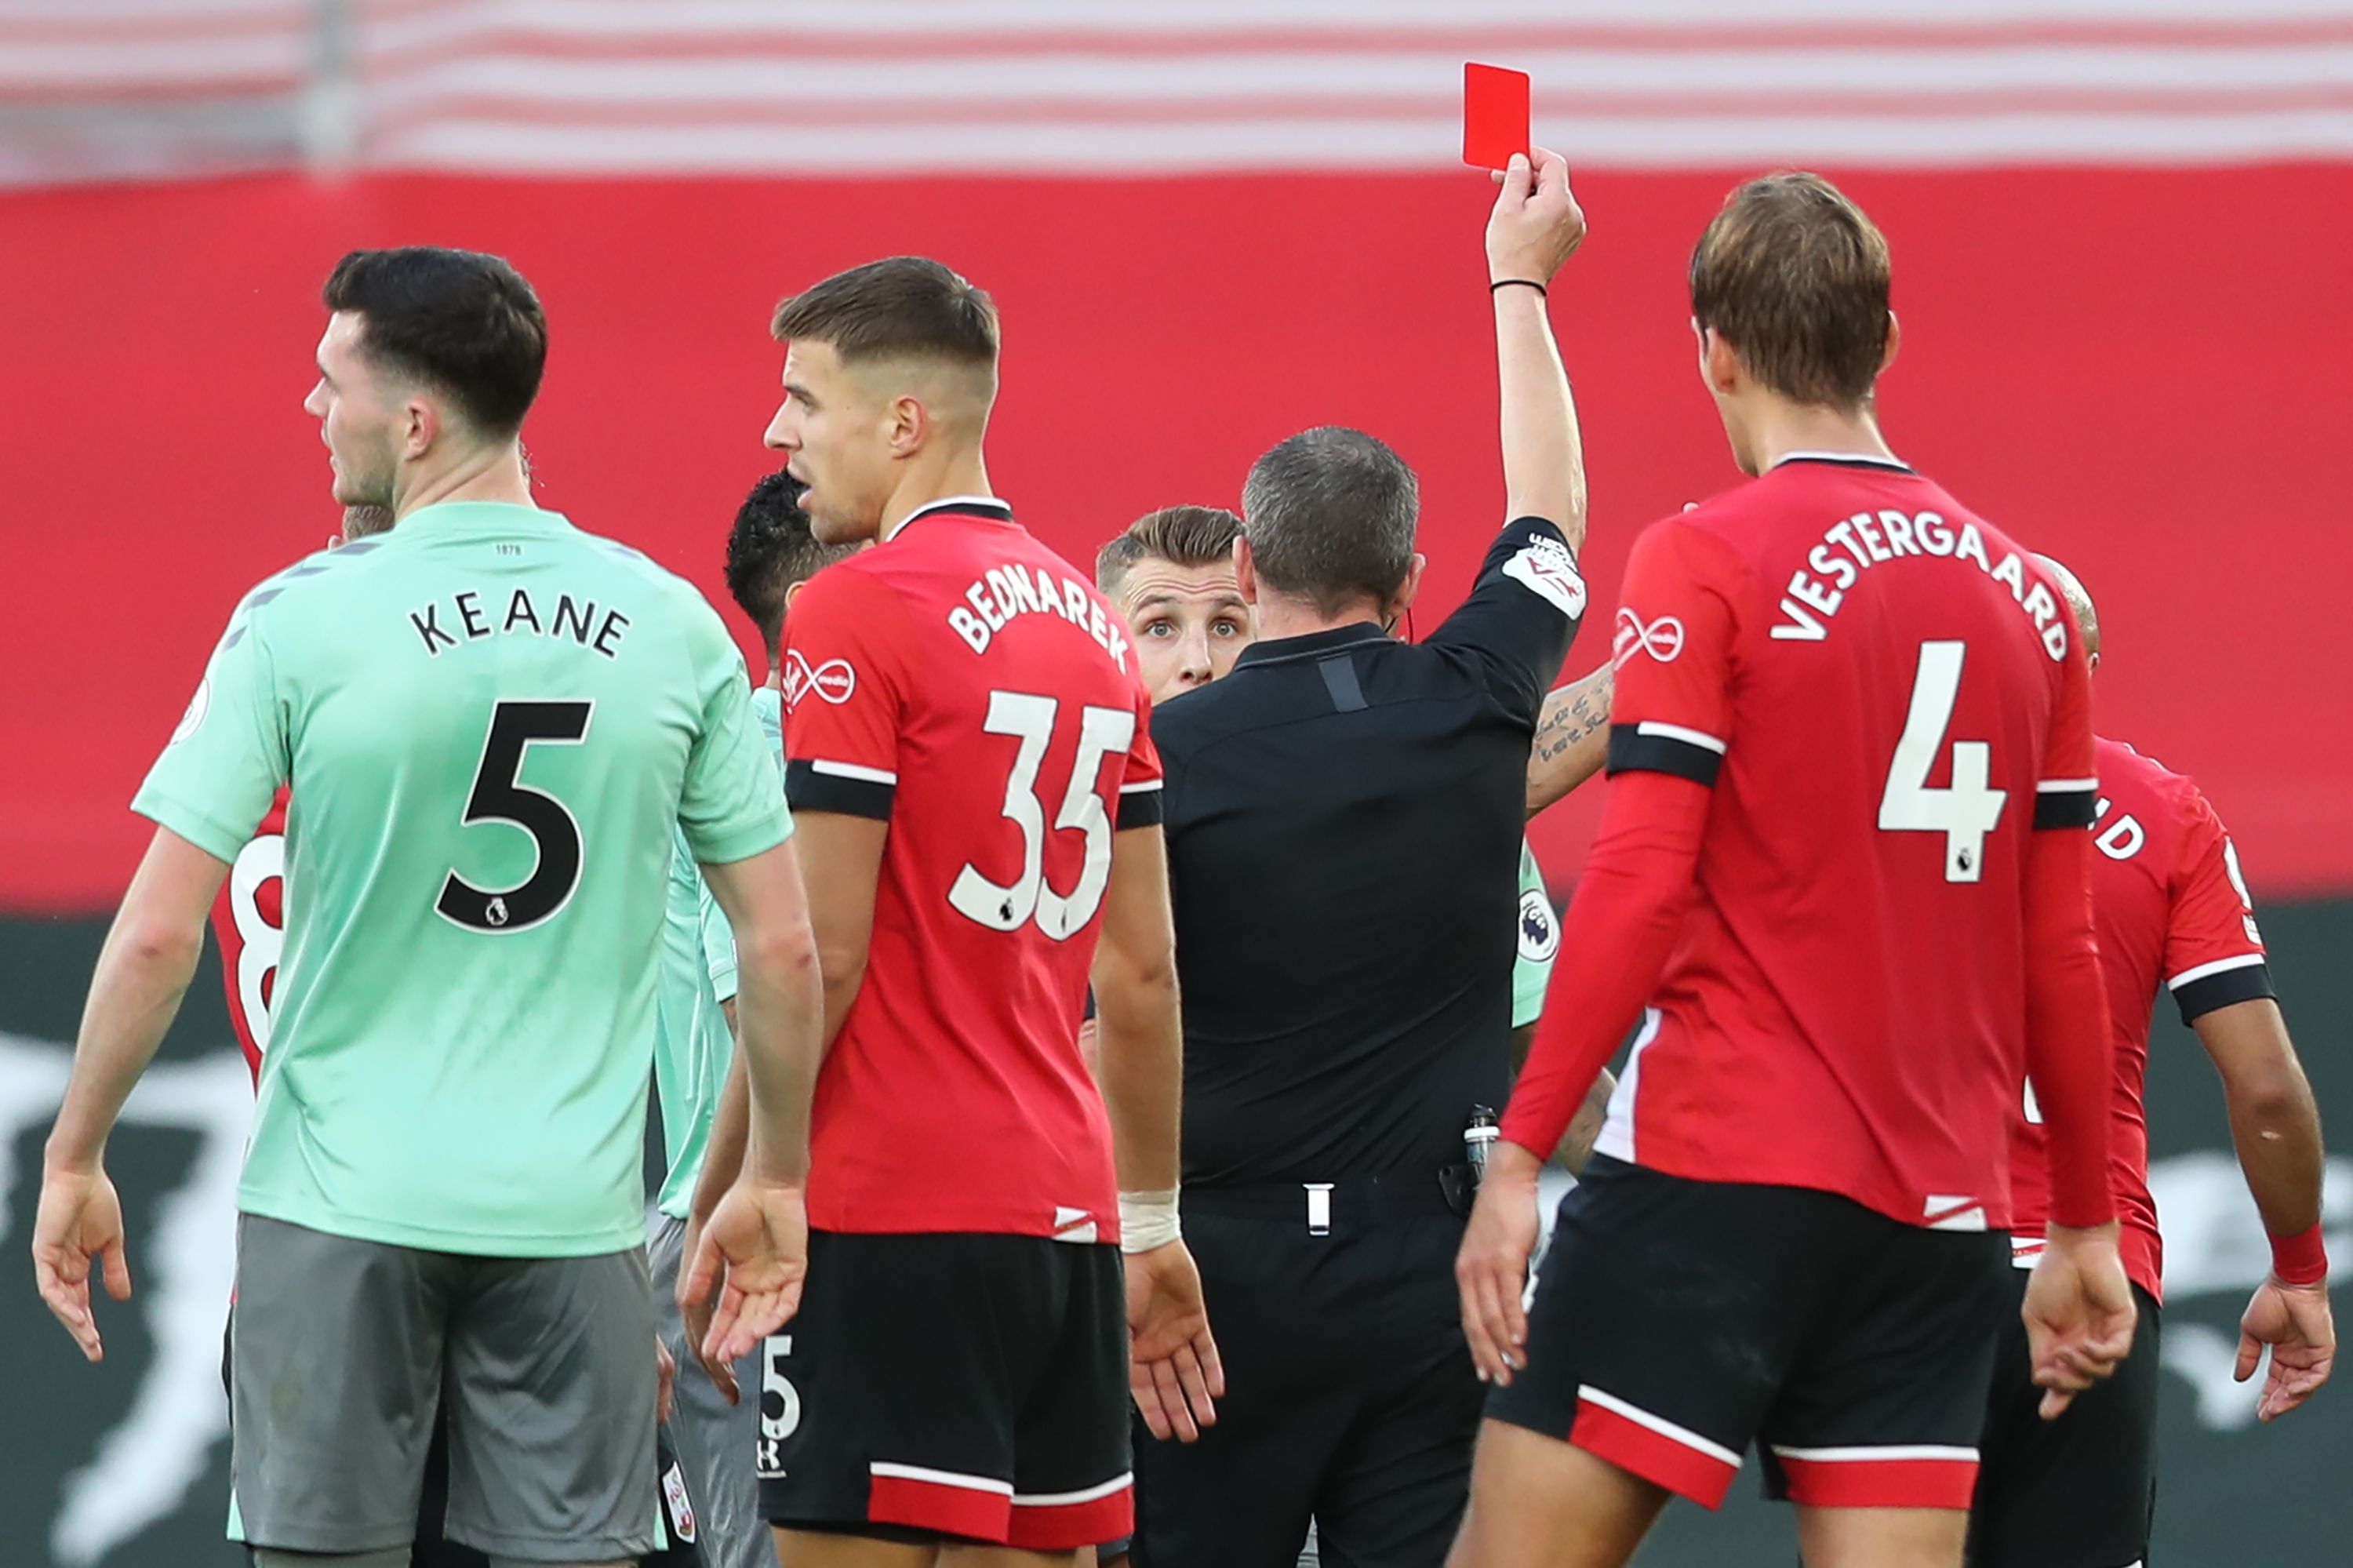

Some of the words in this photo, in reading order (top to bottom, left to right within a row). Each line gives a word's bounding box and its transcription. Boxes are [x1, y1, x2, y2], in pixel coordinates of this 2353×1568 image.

[409, 588, 631, 659] KEANE
[496, 544, 522, 556] 1878
[947, 564, 1129, 675] BEDNAREK
[1769, 509, 2068, 663] VESTERGAARD
[435, 698, 596, 934] 5
[947, 689, 1136, 941] 35
[1877, 639, 2008, 883] 4
